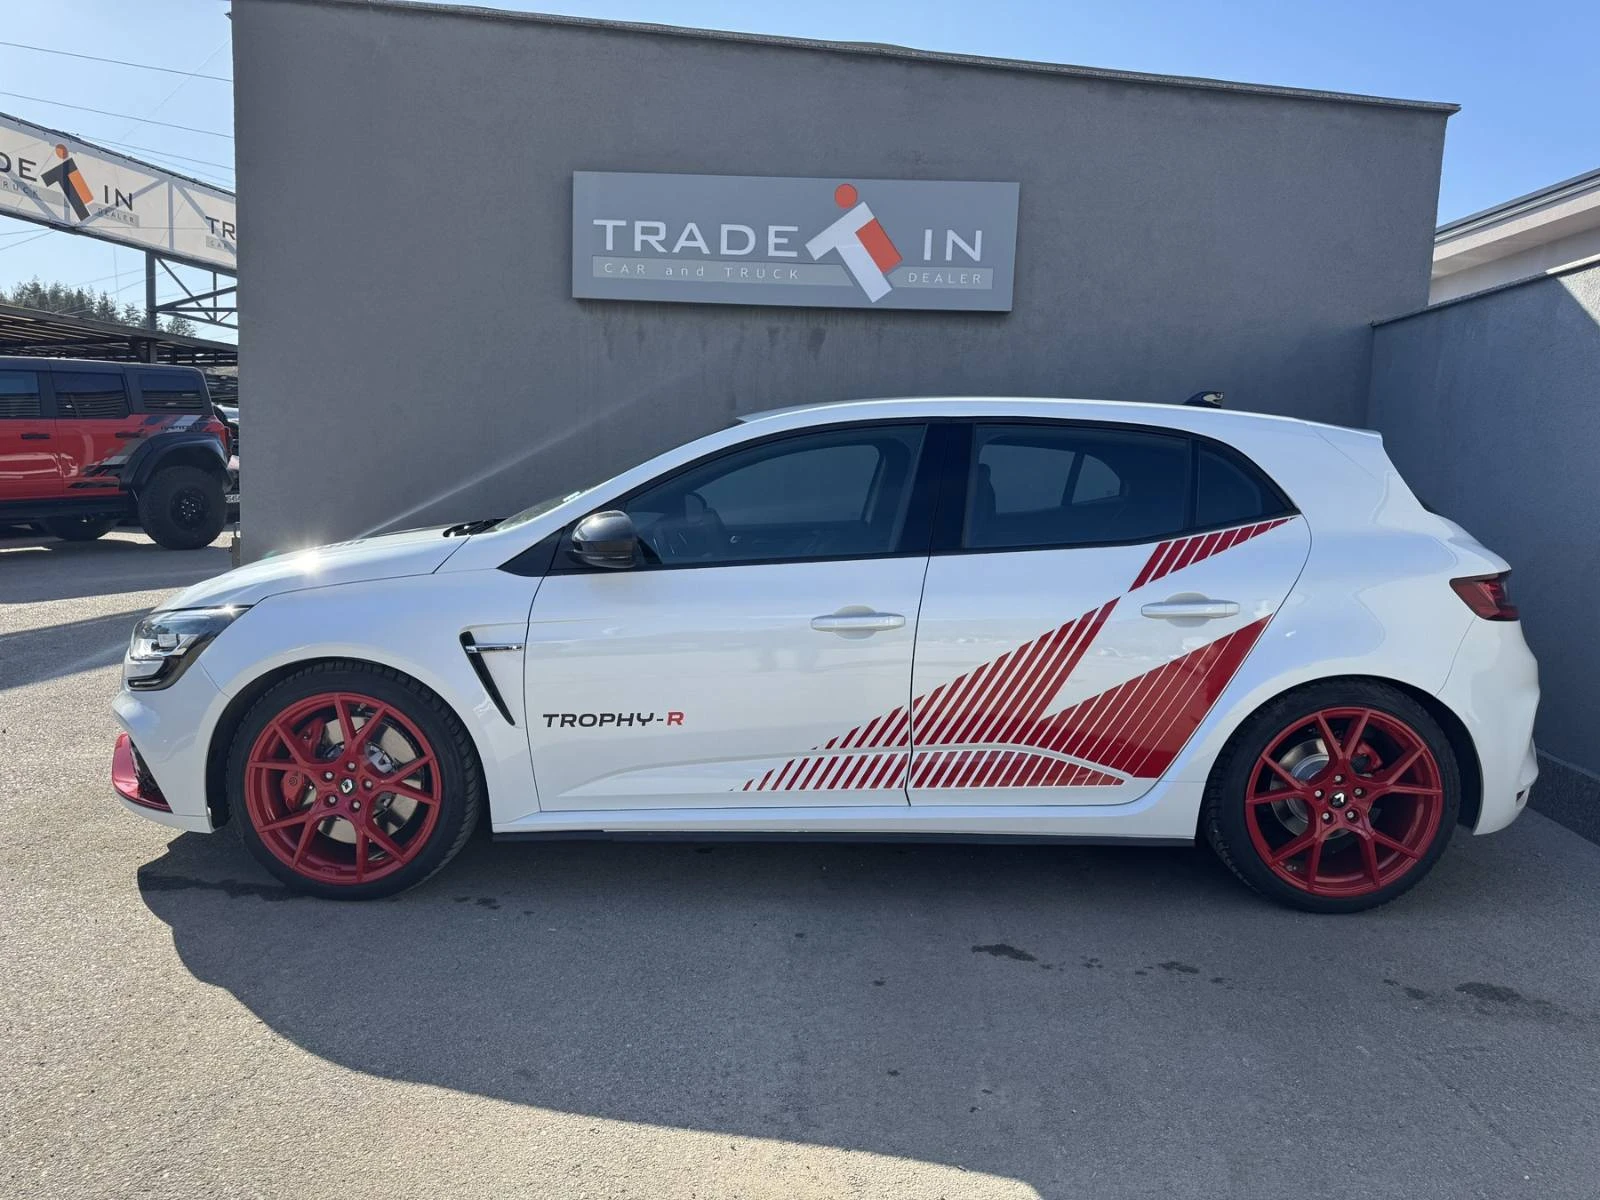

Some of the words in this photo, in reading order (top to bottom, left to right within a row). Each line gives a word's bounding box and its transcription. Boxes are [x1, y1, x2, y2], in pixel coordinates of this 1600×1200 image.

[104, 184, 133, 211] IN
[592, 219, 799, 257] TRADE
[923, 228, 983, 262] IN
[604, 262, 645, 274] CAR
[665, 265, 704, 277] and
[723, 266, 800, 280] TRUCK
[908, 272, 982, 285] DEALER
[542, 711, 685, 728] TROPHY-R
